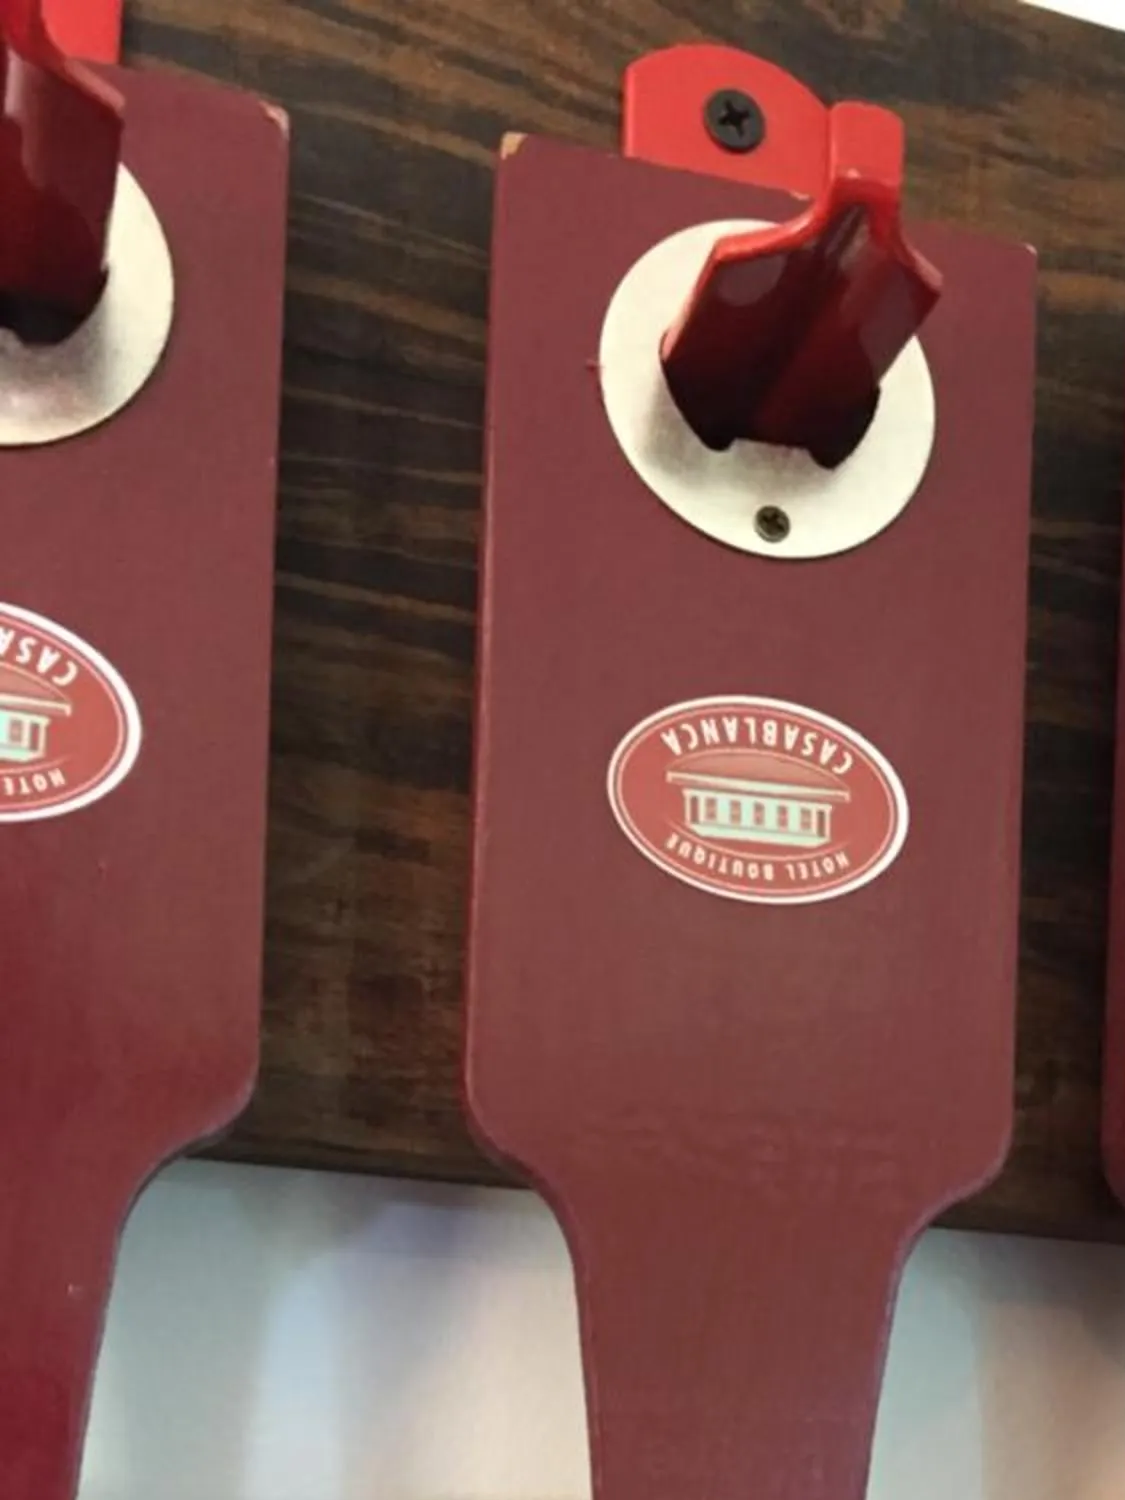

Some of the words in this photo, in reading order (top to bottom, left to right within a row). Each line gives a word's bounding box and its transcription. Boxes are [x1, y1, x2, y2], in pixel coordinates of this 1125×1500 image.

[660, 715, 853, 776] CASABLANCA
[664, 832, 774, 882] BOUTIQUE
[785, 851, 851, 881] HOTEL
